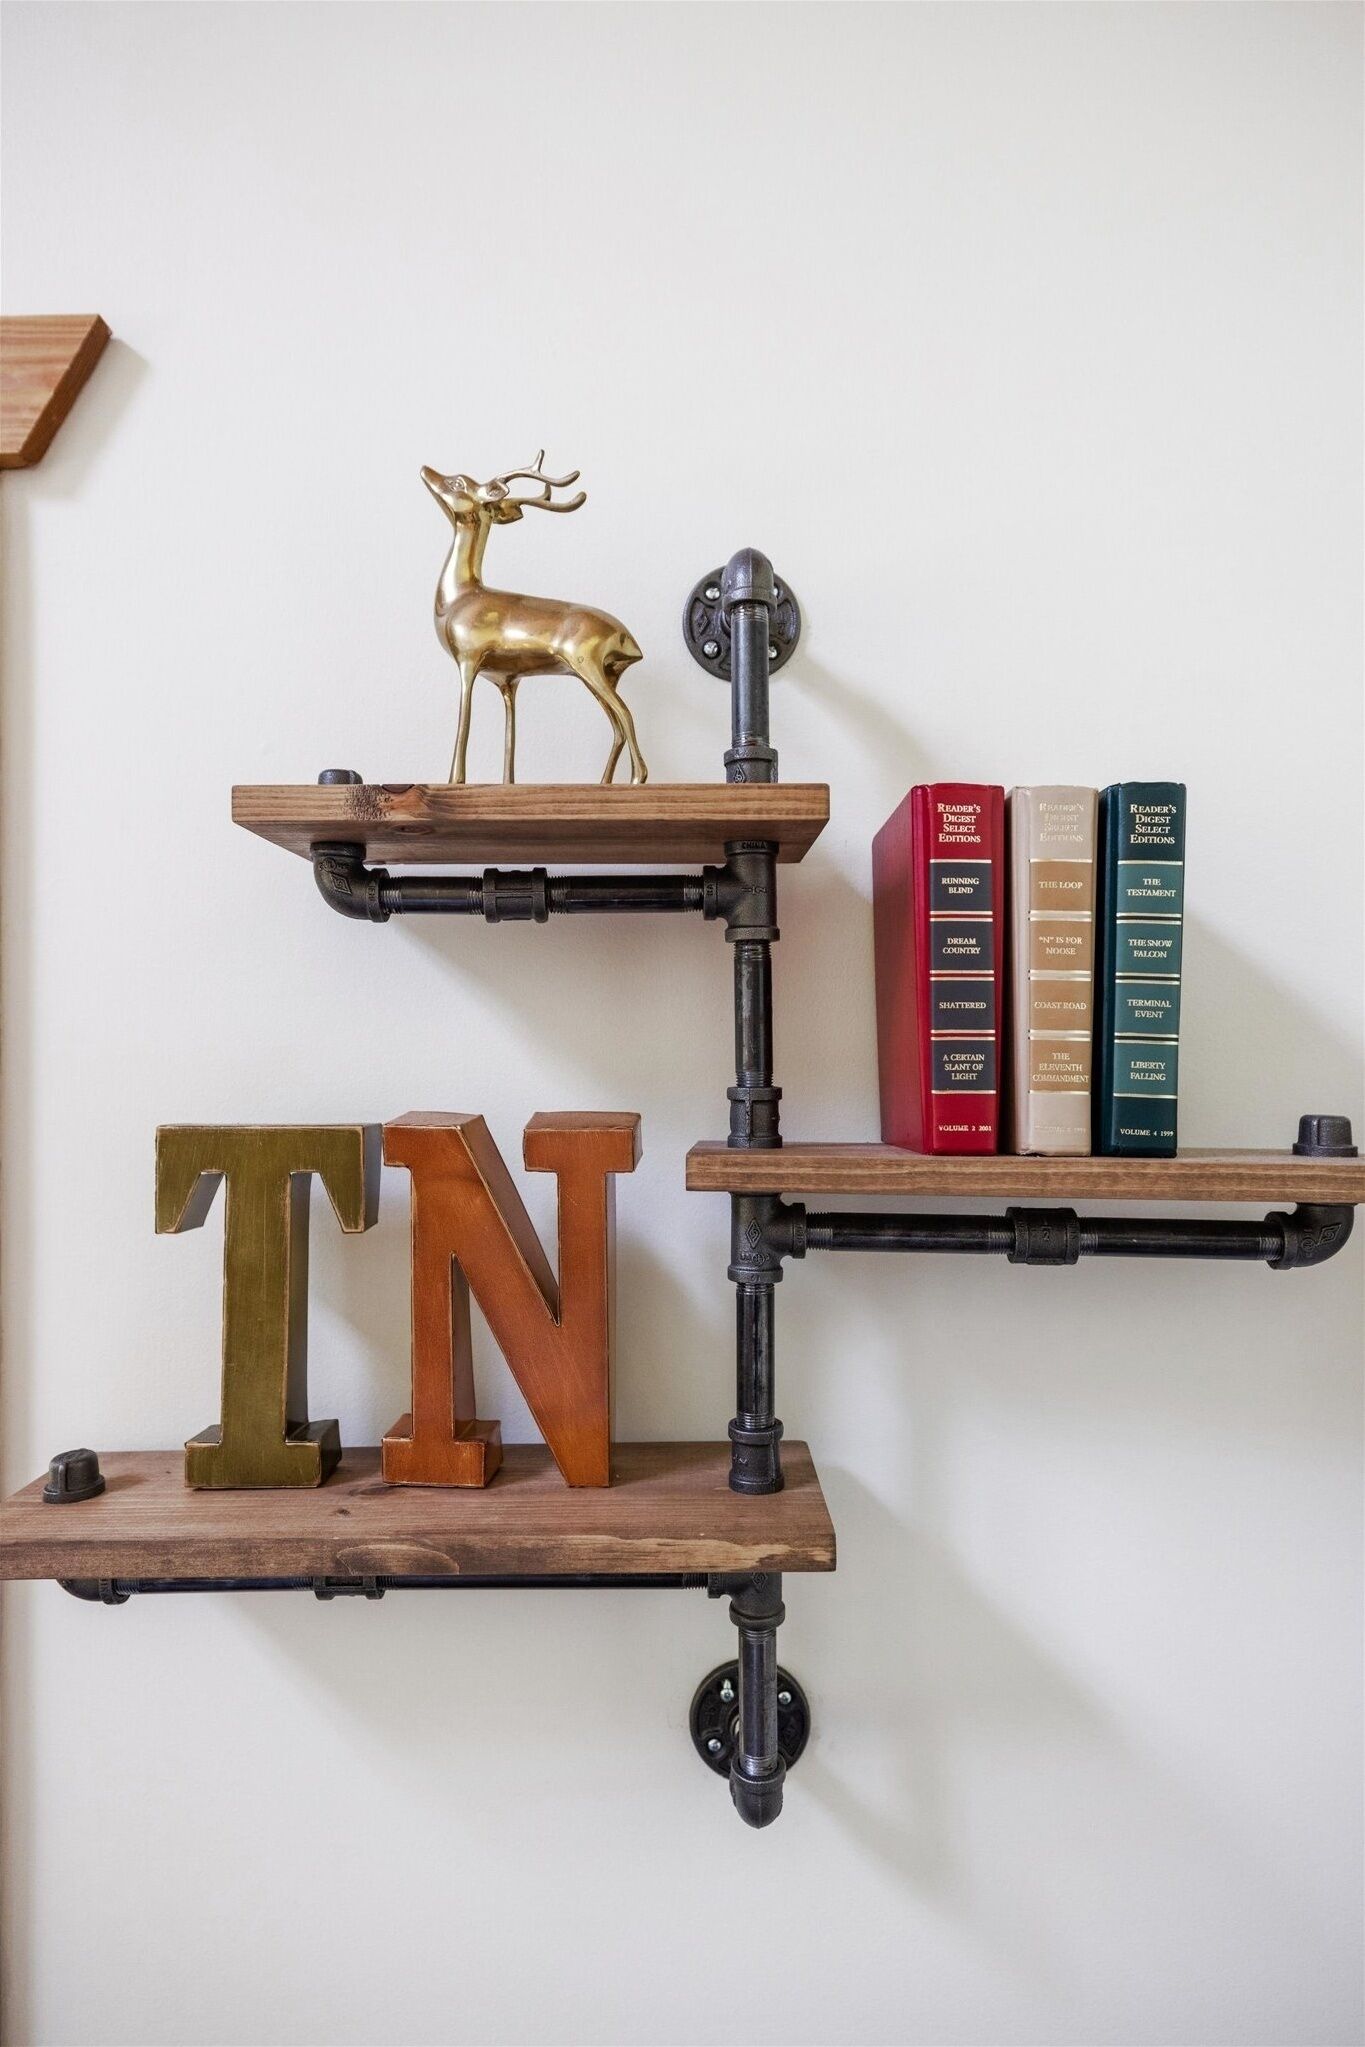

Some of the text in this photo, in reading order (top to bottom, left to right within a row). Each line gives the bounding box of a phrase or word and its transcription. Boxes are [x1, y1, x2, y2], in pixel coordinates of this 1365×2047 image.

[938, 803, 981, 812] READER'S
[1130, 804, 1177, 814] READER'S
[943, 813, 976, 823] DIGEST
[1135, 814, 1171, 824] DIGEST
[943, 824, 976, 833] SELECT
[1135, 824, 1170, 834] SELECT
[939, 834, 981, 843] EDITIONS
[1130, 834, 1175, 844] EDITIONS
[1126, 889, 1176, 897] TESTAMENT
[1133, 950, 1167, 958] FALCON
[1127, 999, 1172, 1008] TERMINAL
[1039, 1064, 1082, 1072] ELEVENTH
[1131, 1061, 1165, 1070] LIBERTY
[1032, 1074, 1089, 1082] COMMANDMENT
[1130, 1072, 1166, 1081] FALLING
